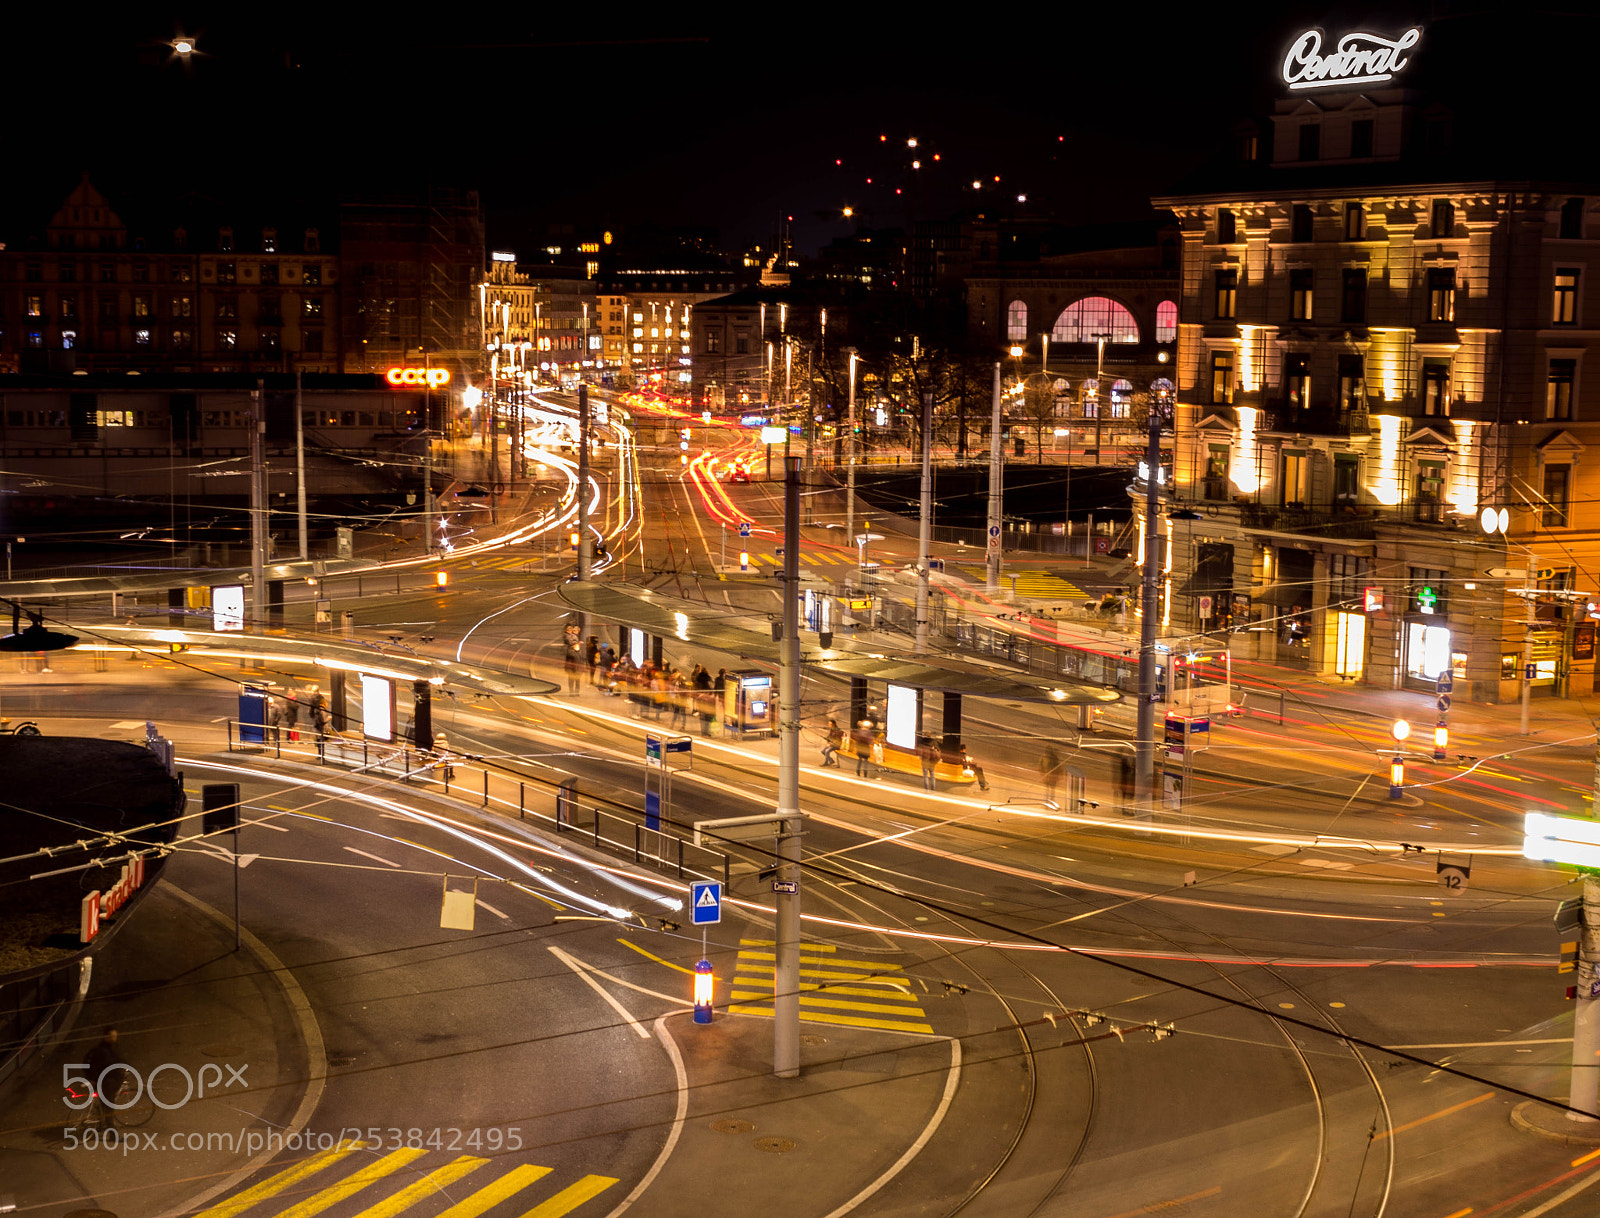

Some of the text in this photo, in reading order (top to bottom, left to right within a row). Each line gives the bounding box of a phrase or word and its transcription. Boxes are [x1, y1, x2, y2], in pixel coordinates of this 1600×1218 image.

[1283, 28, 1420, 84] Central
[387, 367, 451, 390] coop
[1444, 875, 1462, 890] 12
